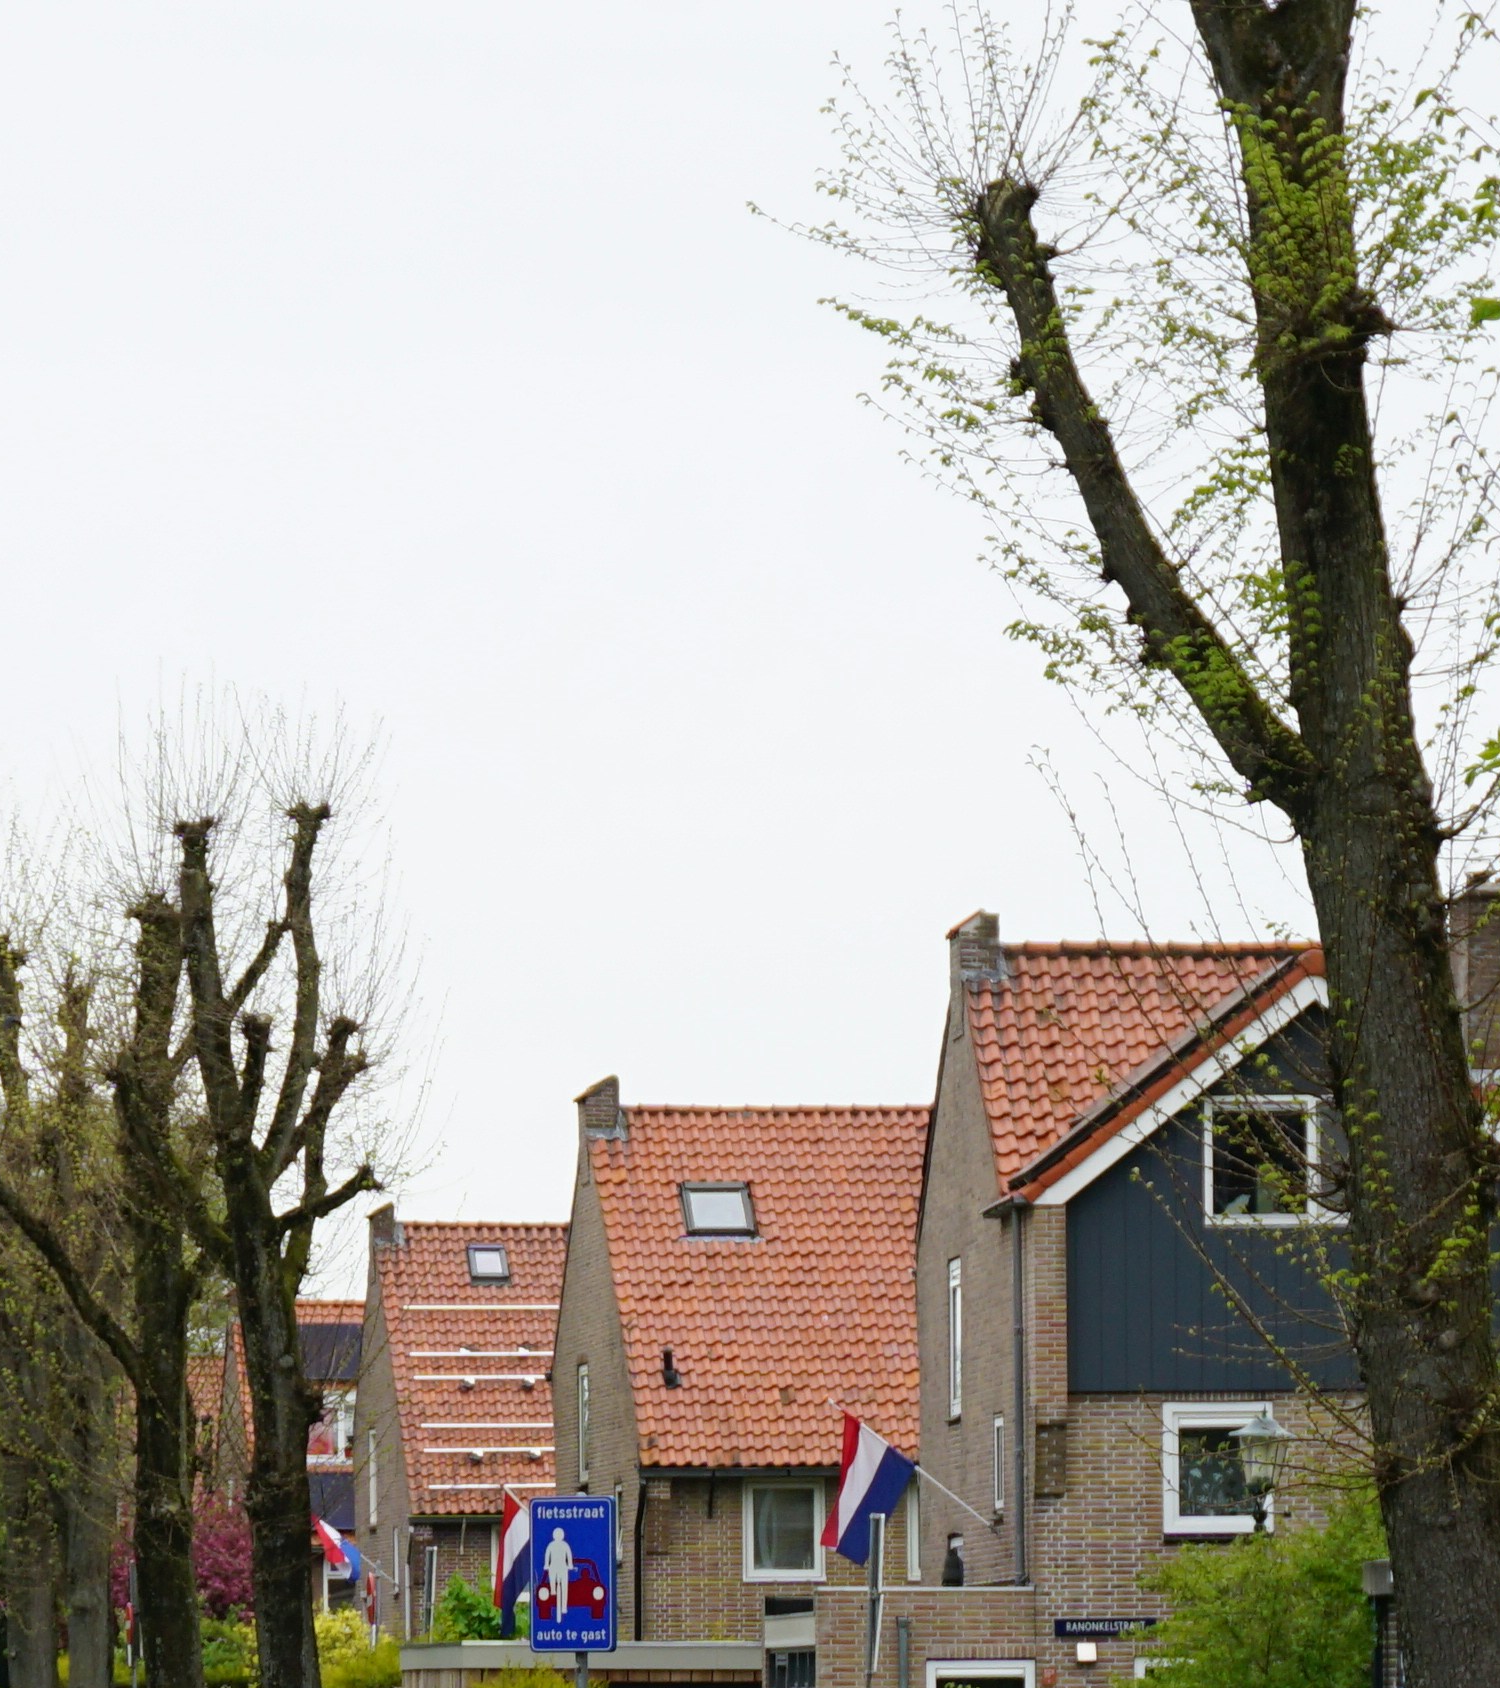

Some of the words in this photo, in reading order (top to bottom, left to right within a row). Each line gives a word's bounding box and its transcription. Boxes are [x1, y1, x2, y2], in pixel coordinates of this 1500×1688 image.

[536, 1505, 605, 1519] fietsstraat
[1066, 1621, 1146, 1632] RANONKELSTRAT
[536, 1629, 563, 1641] auto
[566, 1629, 578, 1641] te
[581, 1628, 607, 1643] gast
